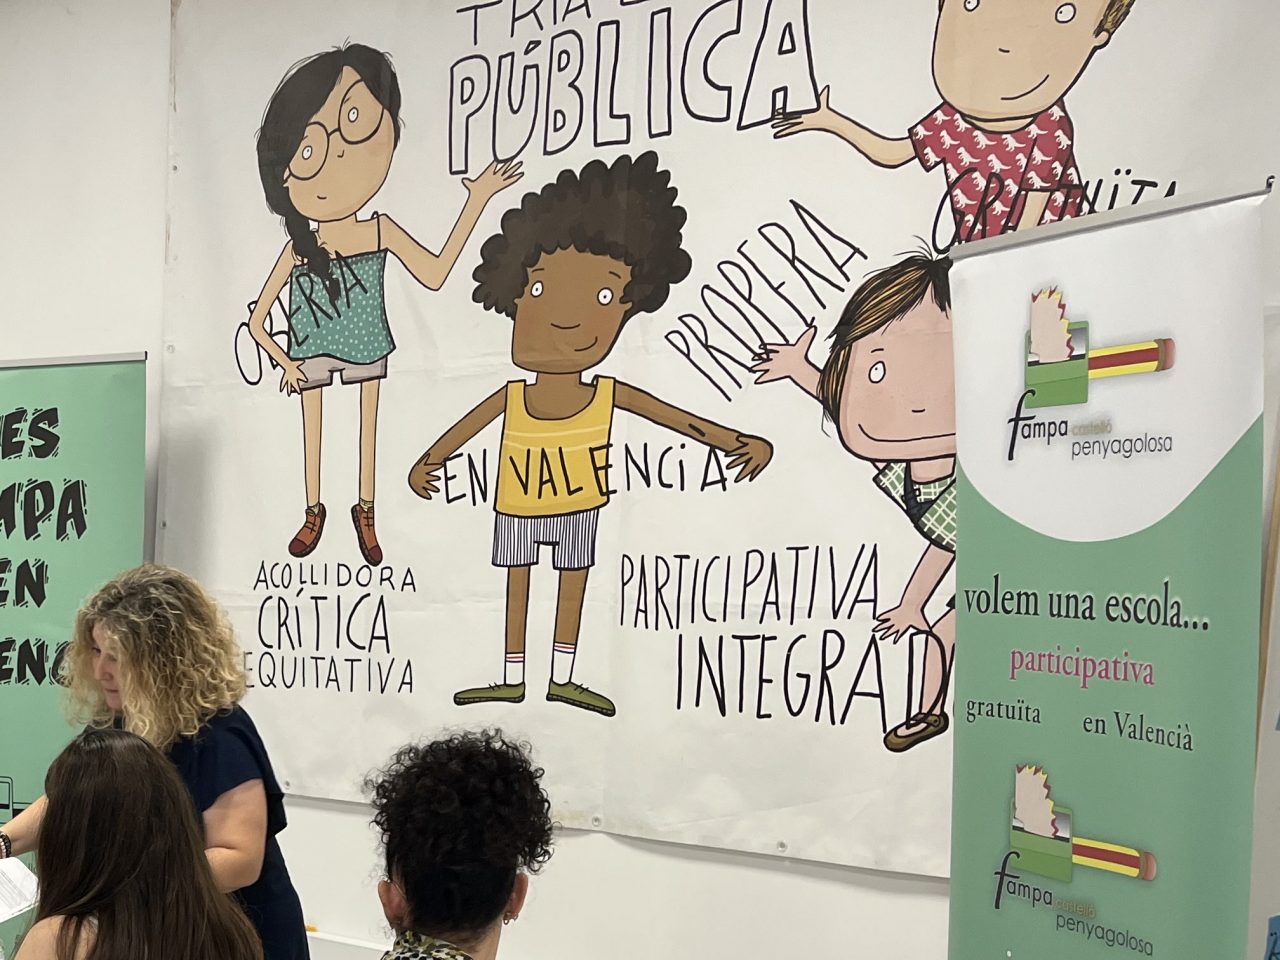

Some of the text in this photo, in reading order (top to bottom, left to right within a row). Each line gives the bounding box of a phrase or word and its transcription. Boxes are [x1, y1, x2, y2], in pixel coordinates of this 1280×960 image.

[448, 0, 821, 175] PÚBLICA
[665, 199, 868, 402] PROPERA
[1007, 388, 1069, 461] fampa
[1071, 433, 1174, 461] penyagolosa
[442, 448, 488, 507] EN
[253, 560, 416, 593] ACOLLIDORA
[620, 543, 878, 631] PARTICIPATIVA
[964, 574, 1210, 632] volem una escola...
[258, 587, 391, 654] CRÍTICA
[243, 651, 414, 695] EQUITATIVA
[677, 629, 953, 735] INTEGRAD
[1010, 645, 1155, 689] participativa
[966, 698, 1041, 725] gratuïta
[1083, 710, 1194, 753] en Valencià
[993, 851, 1052, 909] fampa
[1056, 914, 1154, 957] penyagolosa
